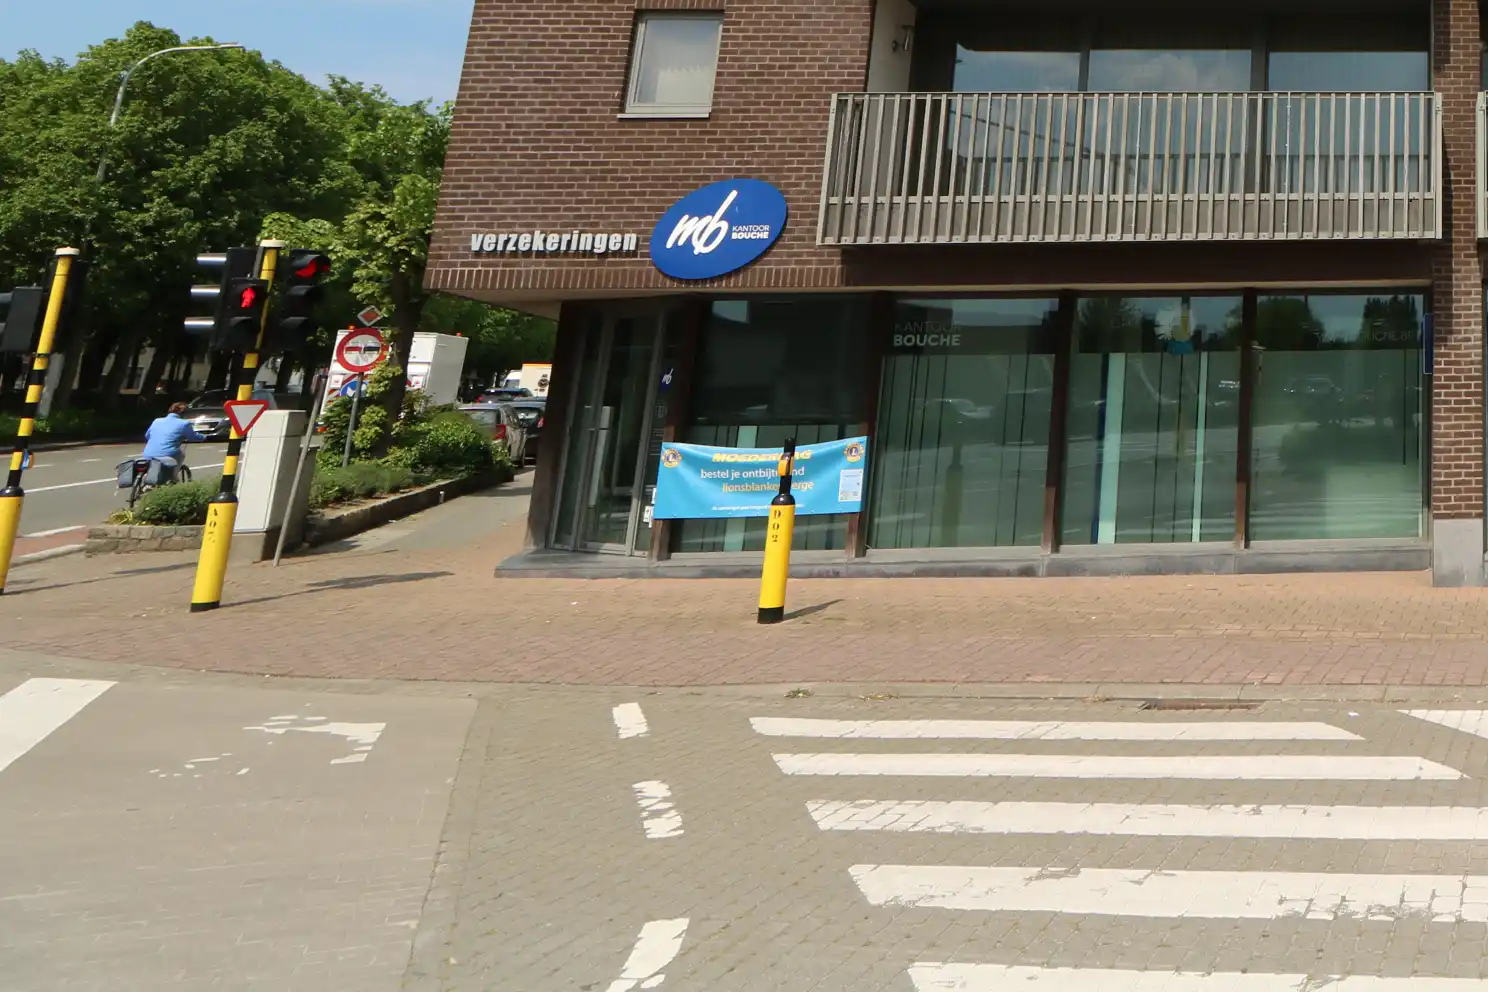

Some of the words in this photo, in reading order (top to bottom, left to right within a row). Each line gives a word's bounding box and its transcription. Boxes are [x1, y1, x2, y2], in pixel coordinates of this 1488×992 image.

[732, 224, 770, 232] KANTOOR
[731, 231, 769, 239] BOUCHE
[471, 230, 637, 254] verzekeringen
[893, 333, 961, 347] BOUCHE
[701, 469, 729, 478] bestel
[731, 470, 741, 480] je
[742, 467, 805, 479] ontbijtnd
[723, 481, 814, 492] lionsblankeerge
